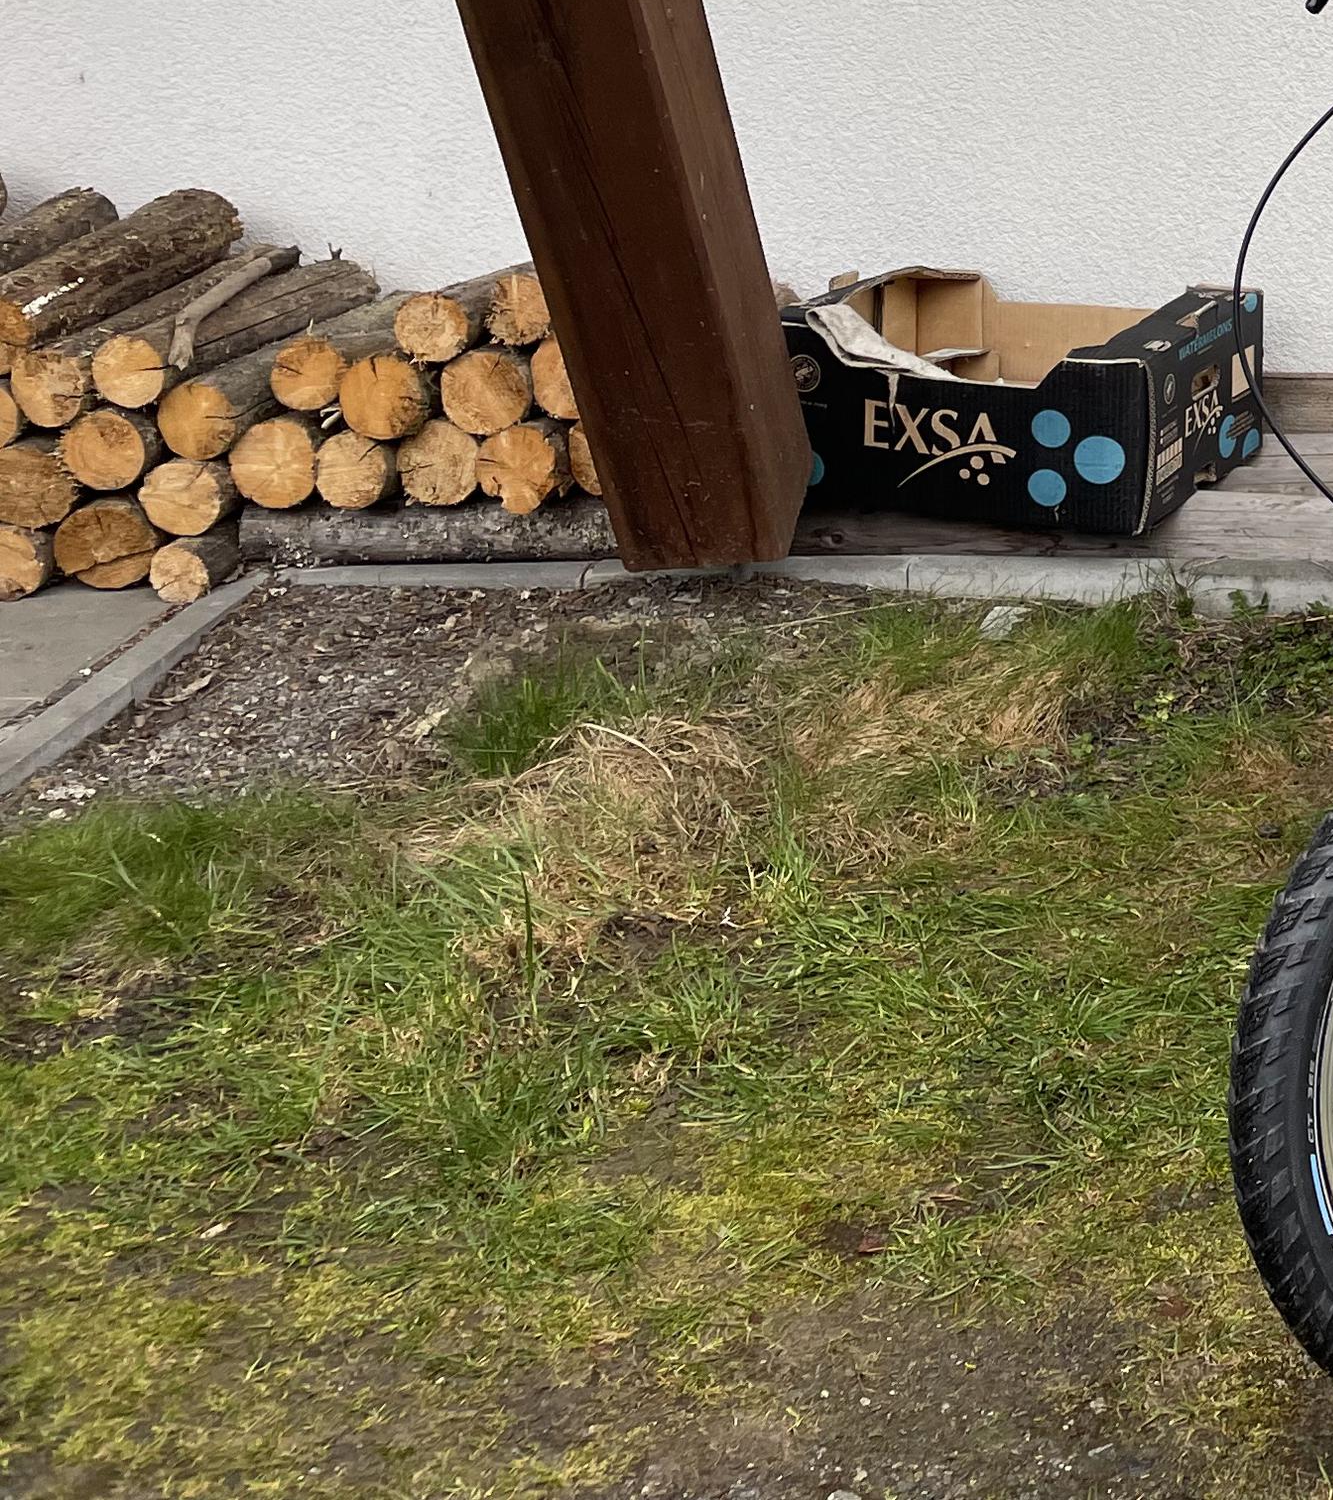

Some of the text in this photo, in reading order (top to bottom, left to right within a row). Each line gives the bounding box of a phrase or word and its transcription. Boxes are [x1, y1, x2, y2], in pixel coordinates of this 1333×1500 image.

[1178, 318, 1233, 362] WATERMELONS
[864, 398, 1008, 465] EXSA
[1184, 389, 1220, 439] EXSA
